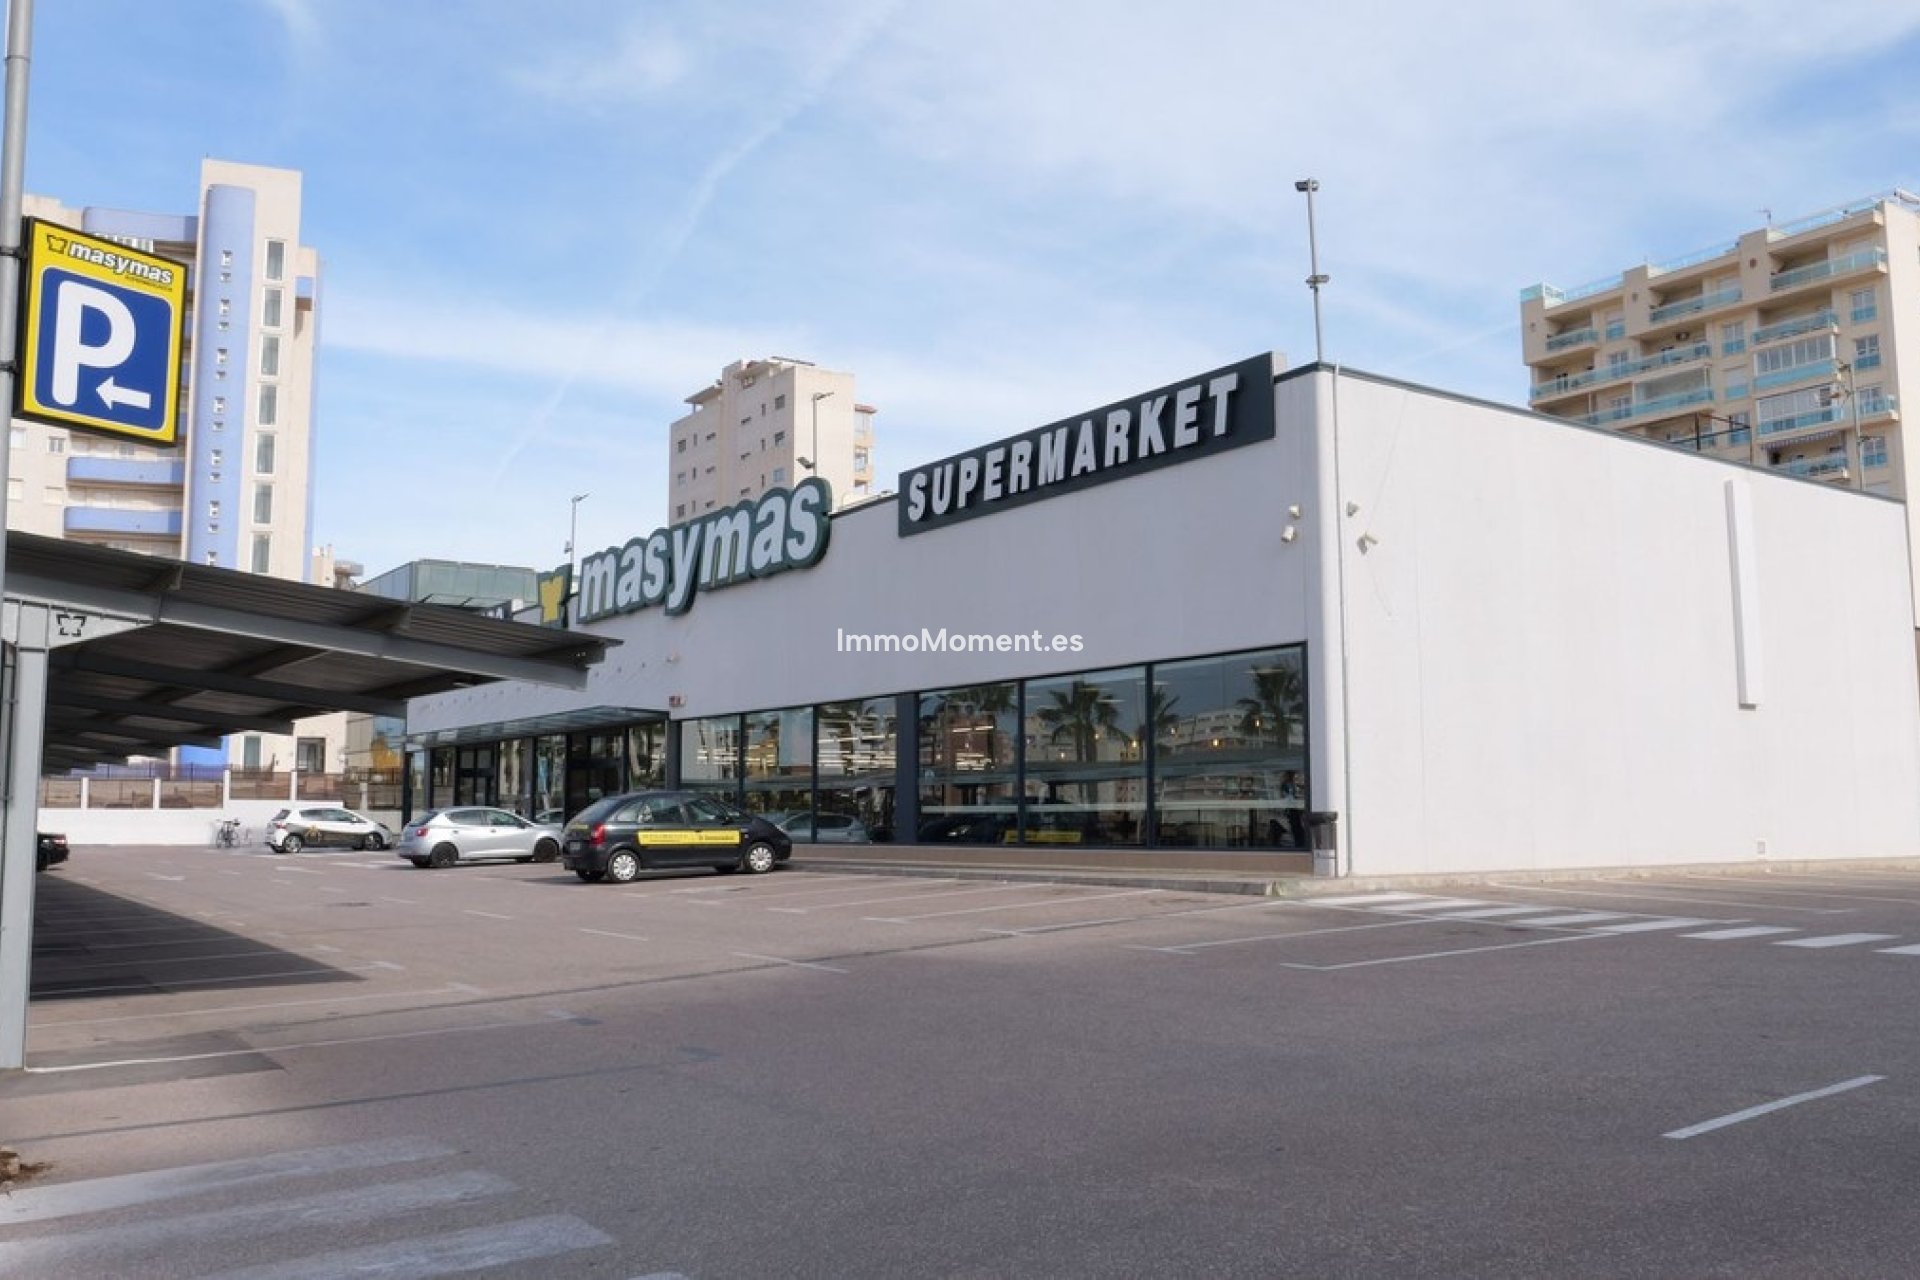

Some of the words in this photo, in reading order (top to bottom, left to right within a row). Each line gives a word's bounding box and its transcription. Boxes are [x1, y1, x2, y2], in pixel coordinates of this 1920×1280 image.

[69, 241, 173, 285] masymas
[52, 280, 136, 406] P
[907, 372, 1239, 523] SUPERMARKET
[578, 480, 825, 619] masymas
